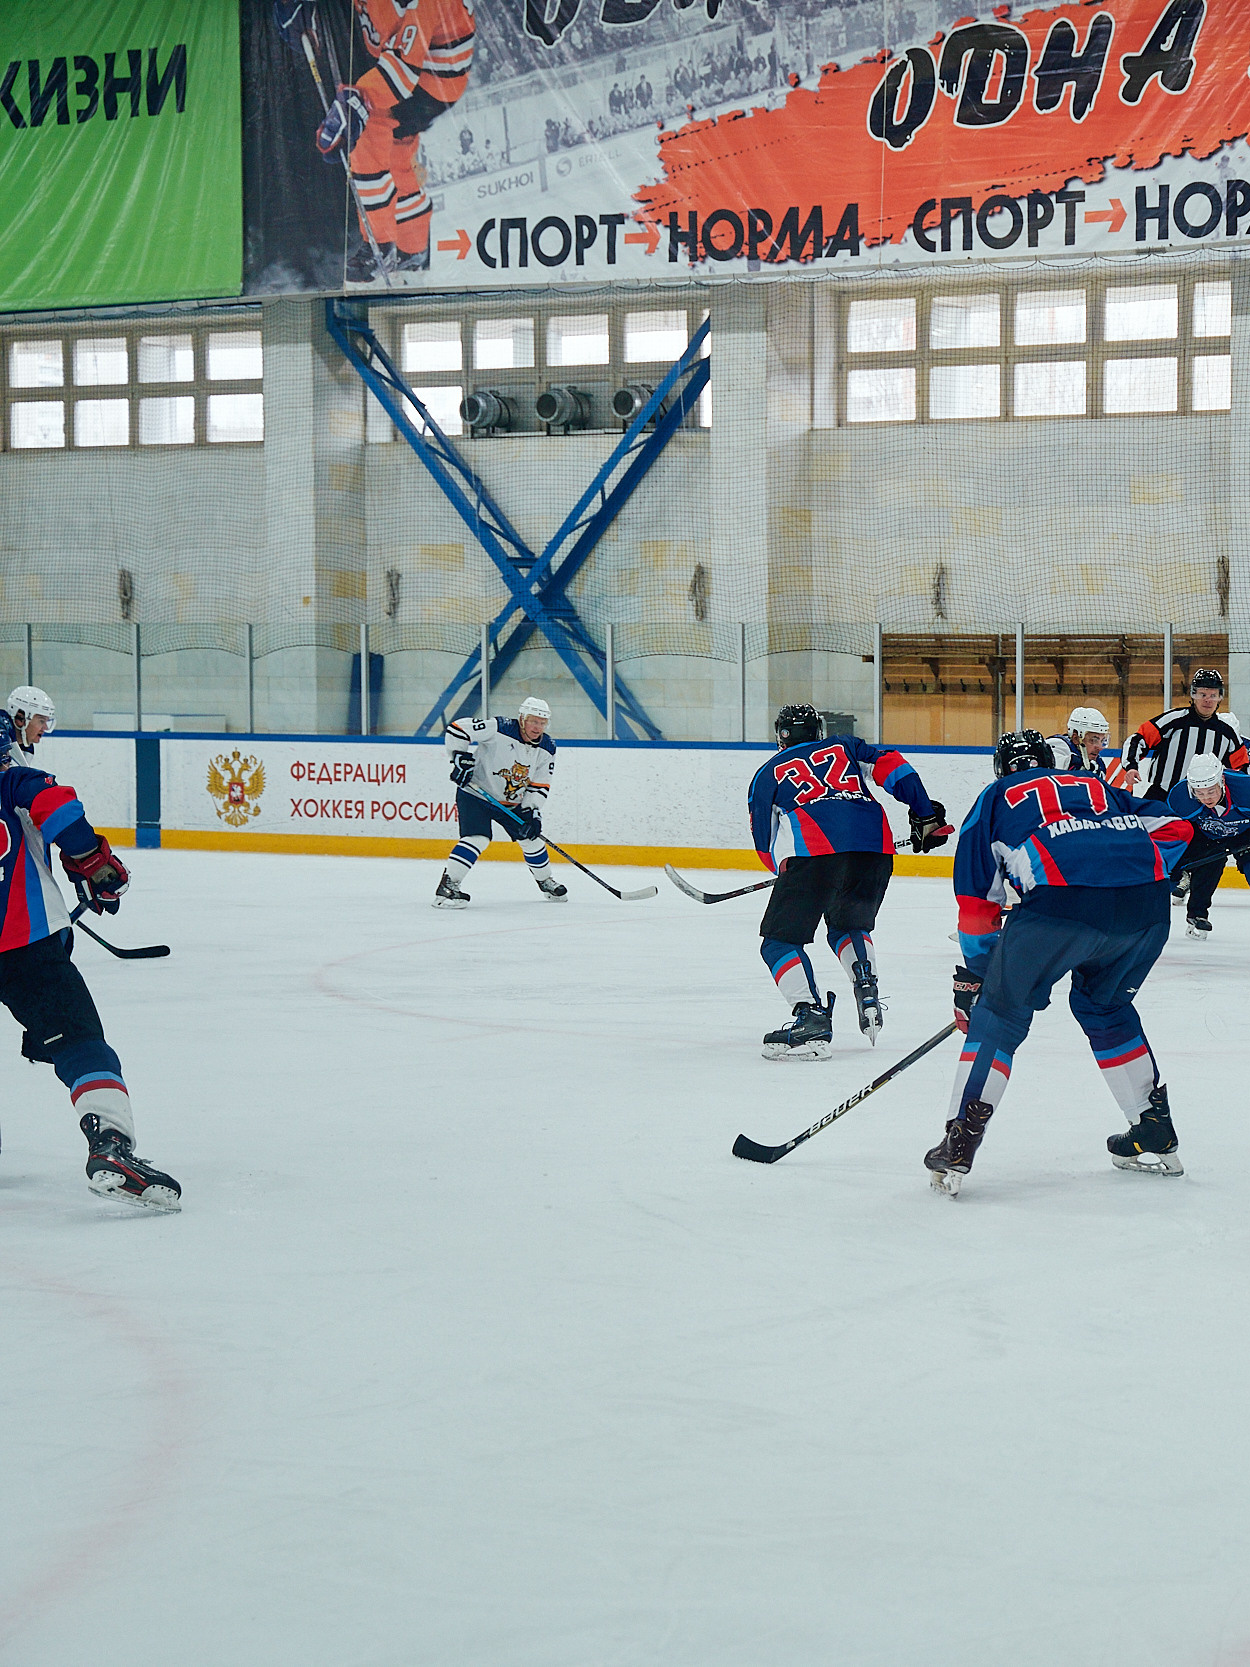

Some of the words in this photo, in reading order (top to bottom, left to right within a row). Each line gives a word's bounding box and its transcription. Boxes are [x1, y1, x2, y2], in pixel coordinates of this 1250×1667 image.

[477, 172, 534, 199] SUKHOI
[476, 214, 625, 269] СПОРТ
[668, 203, 860, 262] НОРМА
[913, 190, 1086, 253] СПОРТ
[290, 761, 406, 786] ФЕДЕРАЦИЯ
[774, 744, 862, 806] 32
[290, 798, 364, 819] ХОККЕЯ
[1004, 775, 1109, 828] 77
